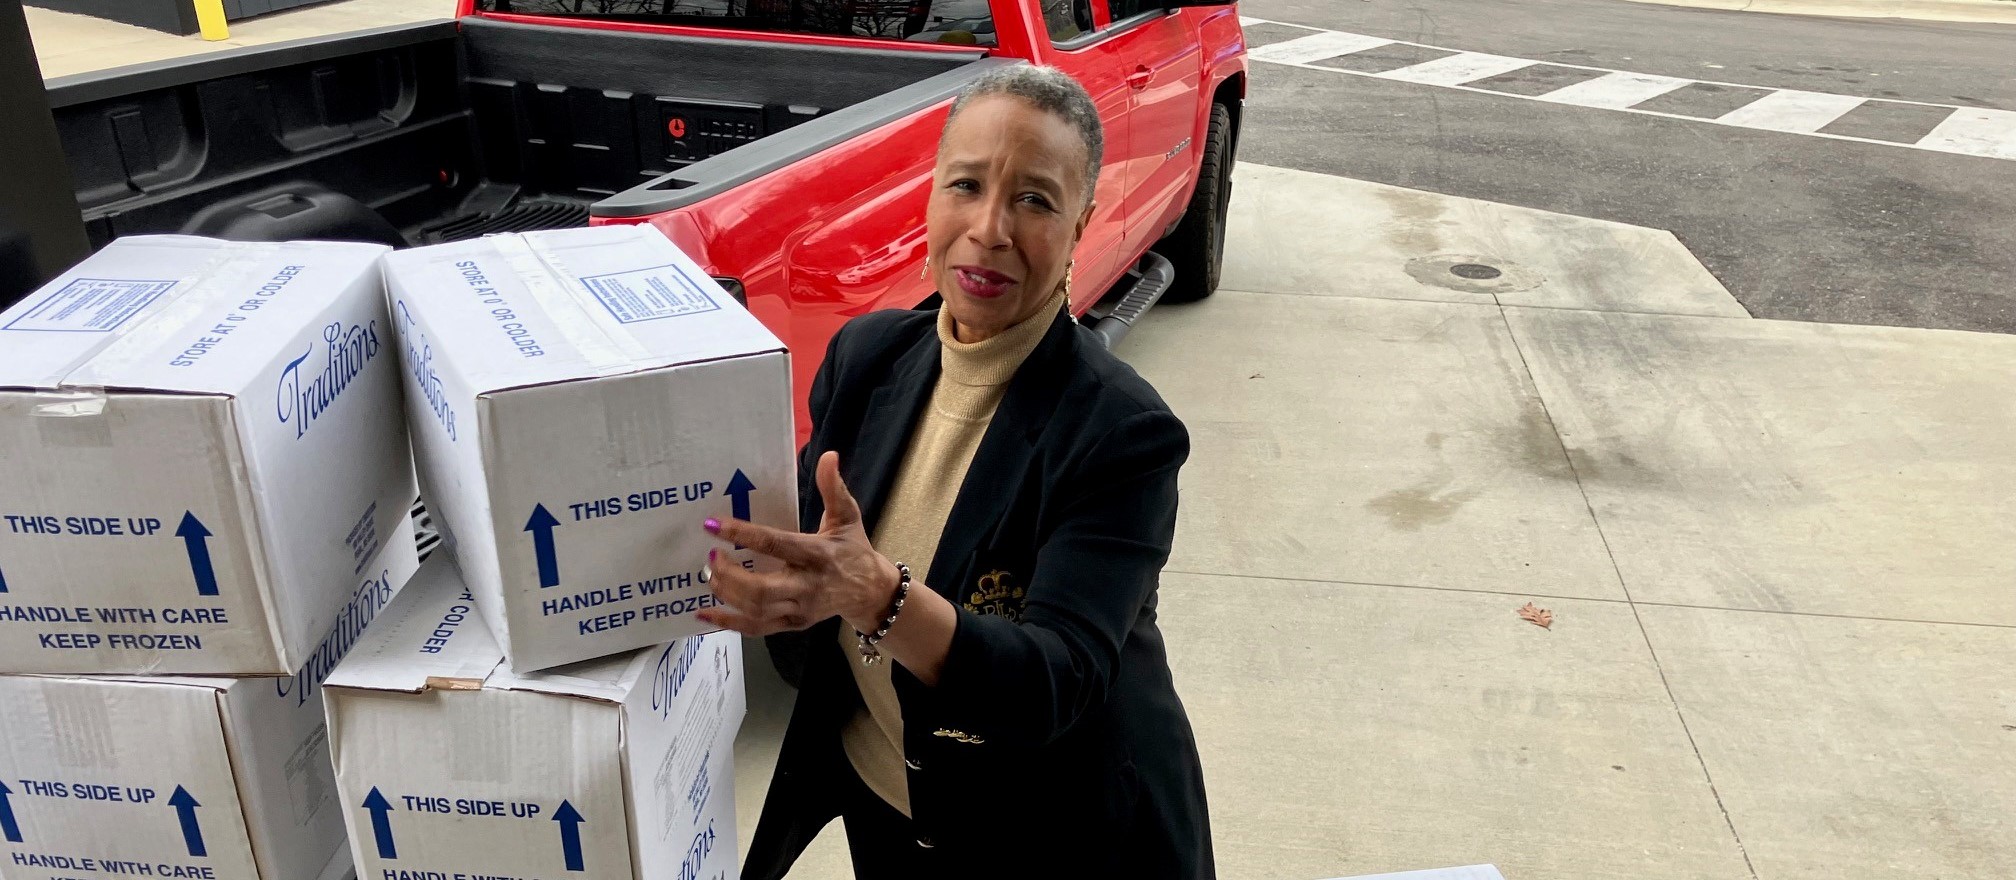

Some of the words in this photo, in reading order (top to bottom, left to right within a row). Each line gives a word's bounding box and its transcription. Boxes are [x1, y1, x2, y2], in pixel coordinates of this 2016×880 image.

[455, 260, 489, 286] STORE
[474, 287, 498, 296] AT
[169, 336, 222, 367] STORE
[210, 323, 237, 335] AT
[238, 298, 268, 311] OR
[255, 265, 305, 297] COLDER
[491, 308, 516, 321] OR
[502, 322, 545, 358] COLDER
[277, 320, 381, 440] Traditions
[397, 299, 456, 442] Traditions
[568, 497, 623, 522] THIS
[626, 487, 680, 512] SIDE
[683, 481, 714, 502] UP
[3, 515, 62, 535] THIS
[65, 516, 124, 536] SIDE
[127, 517, 161, 536] UP
[541, 583, 634, 617] HANDLE
[637, 572, 692, 596] WITH
[0, 605, 93, 623] HANDLE
[94, 607, 157, 624] WITH
[161, 607, 229, 624] CARE
[578, 610, 636, 636] KEEP
[38, 633, 101, 649] KEEP
[106, 634, 202, 650] FROZEN
[419, 604, 470, 655] COLDER
[18, 779, 69, 798] THIS
[71, 783, 123, 802] SIDE
[125, 787, 156, 804] UP
[401, 795, 452, 814] THIS
[455, 798, 507, 817] SIDE
[510, 802, 541, 819] UP
[11, 851, 98, 872] HANDLE
[98, 859, 154, 876] WITH
[156, 863, 216, 880] CARE
